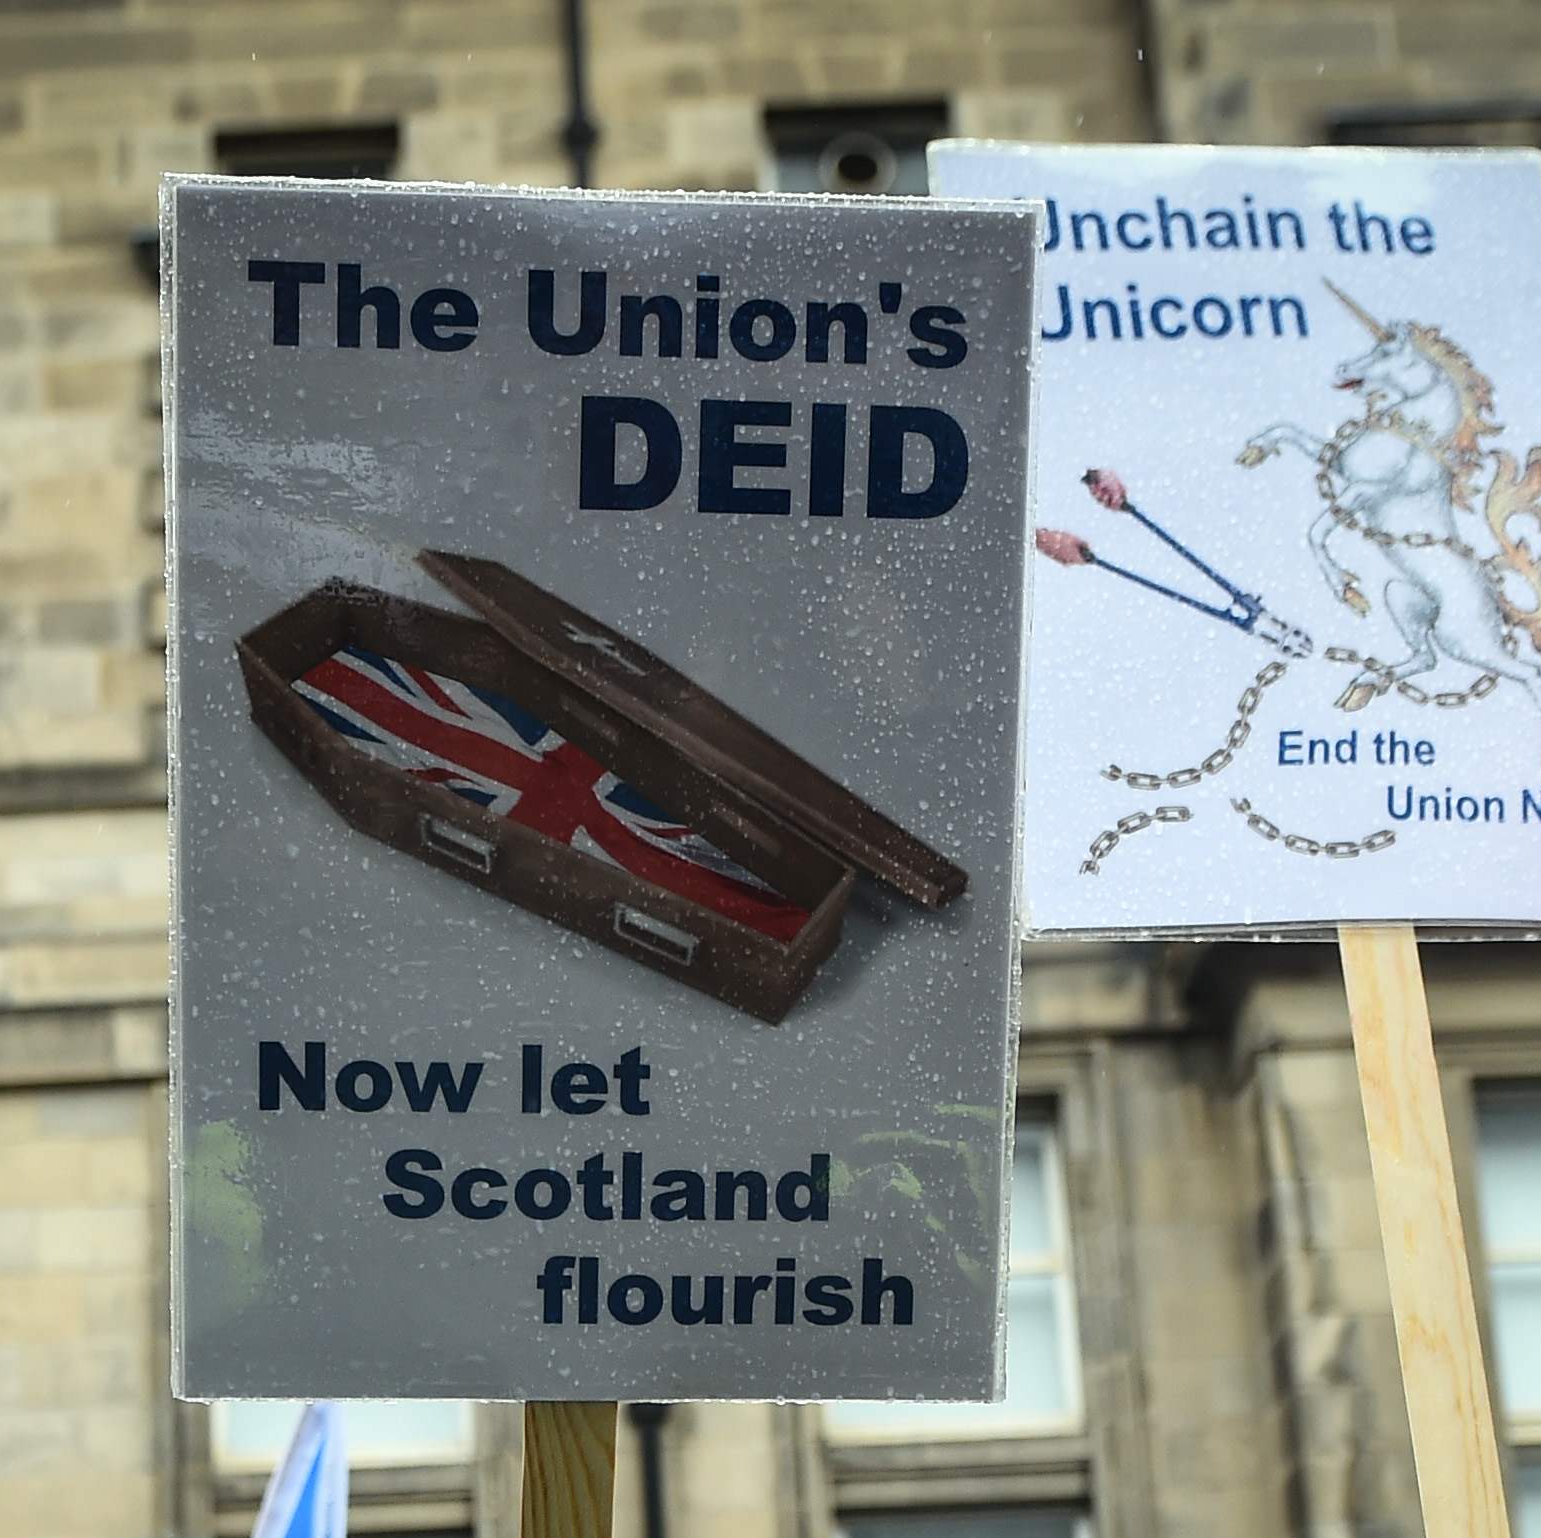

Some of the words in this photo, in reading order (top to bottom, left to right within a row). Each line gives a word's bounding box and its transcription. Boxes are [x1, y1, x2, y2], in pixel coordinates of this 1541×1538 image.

[1328, 202, 1434, 256] the
[248, 259, 479, 353] The
[527, 269, 968, 370] Union's
[579, 395, 969, 520] DEID
[1278, 730, 1357, 766] End
[1373, 730, 1435, 766] the
[1387, 785, 1505, 823] Union
[258, 1040, 485, 1114] Now
[521, 1044, 651, 1116] let
[382, 1148, 831, 1223] Scotland
[536, 1255, 914, 1326] flourish
